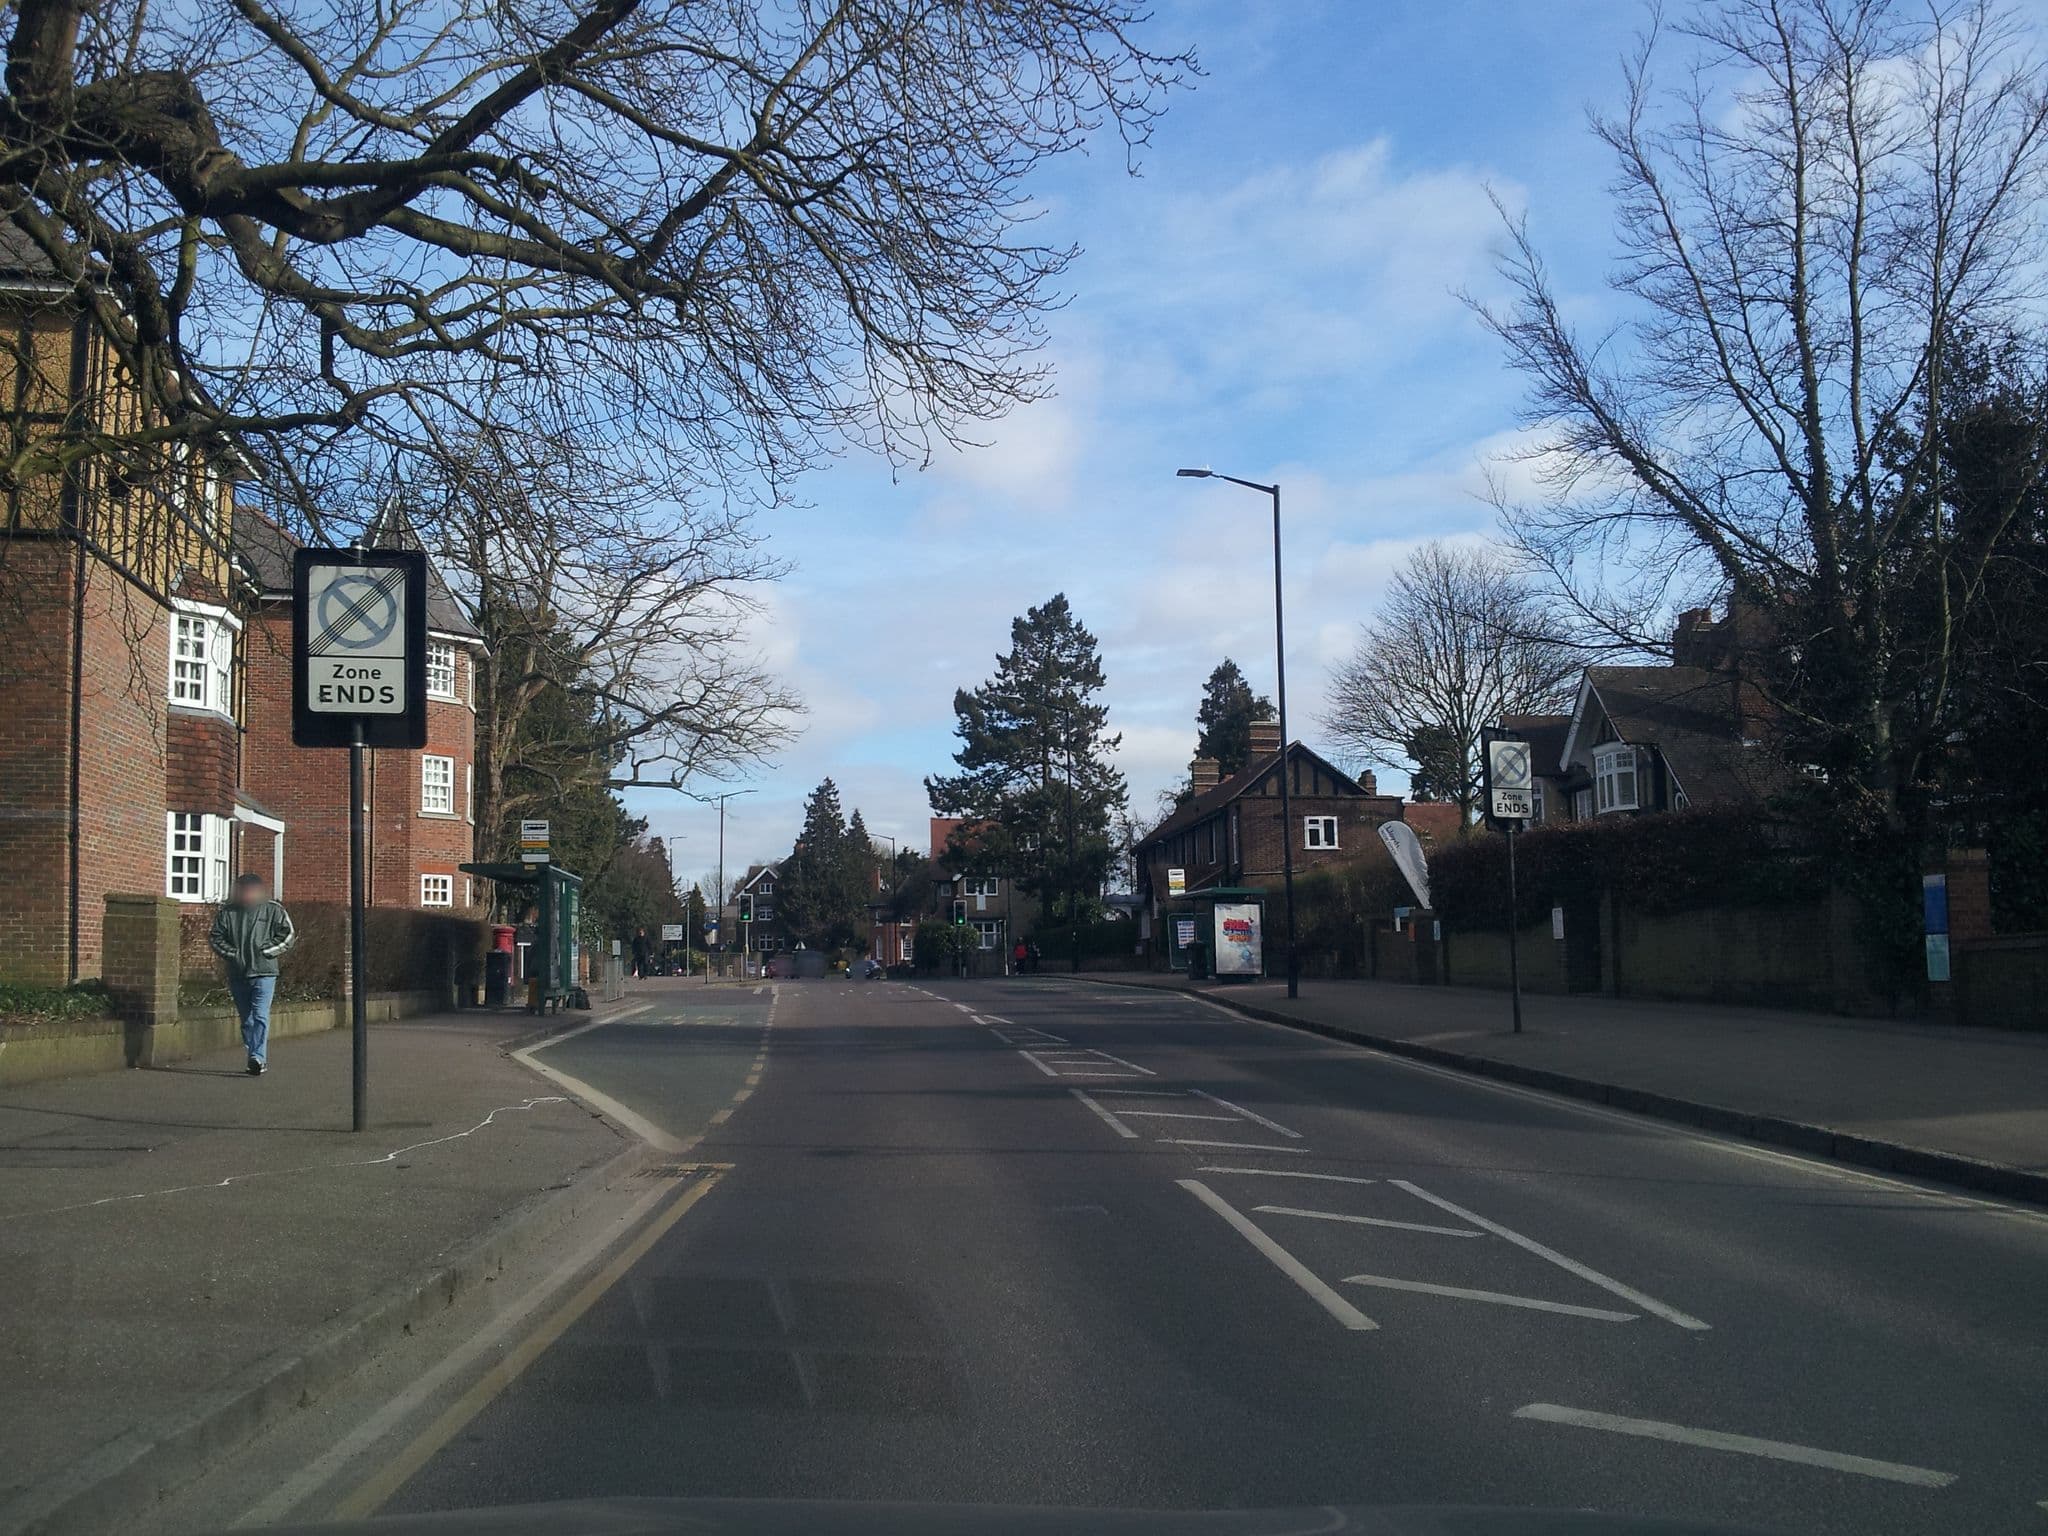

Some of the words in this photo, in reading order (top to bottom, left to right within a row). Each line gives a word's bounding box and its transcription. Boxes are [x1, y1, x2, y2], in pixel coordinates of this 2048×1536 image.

[333, 664, 382, 679] Zone
[319, 685, 395, 704] ENDS
[1502, 792, 1522, 801] Zone
[1496, 803, 1528, 813] ENDS
